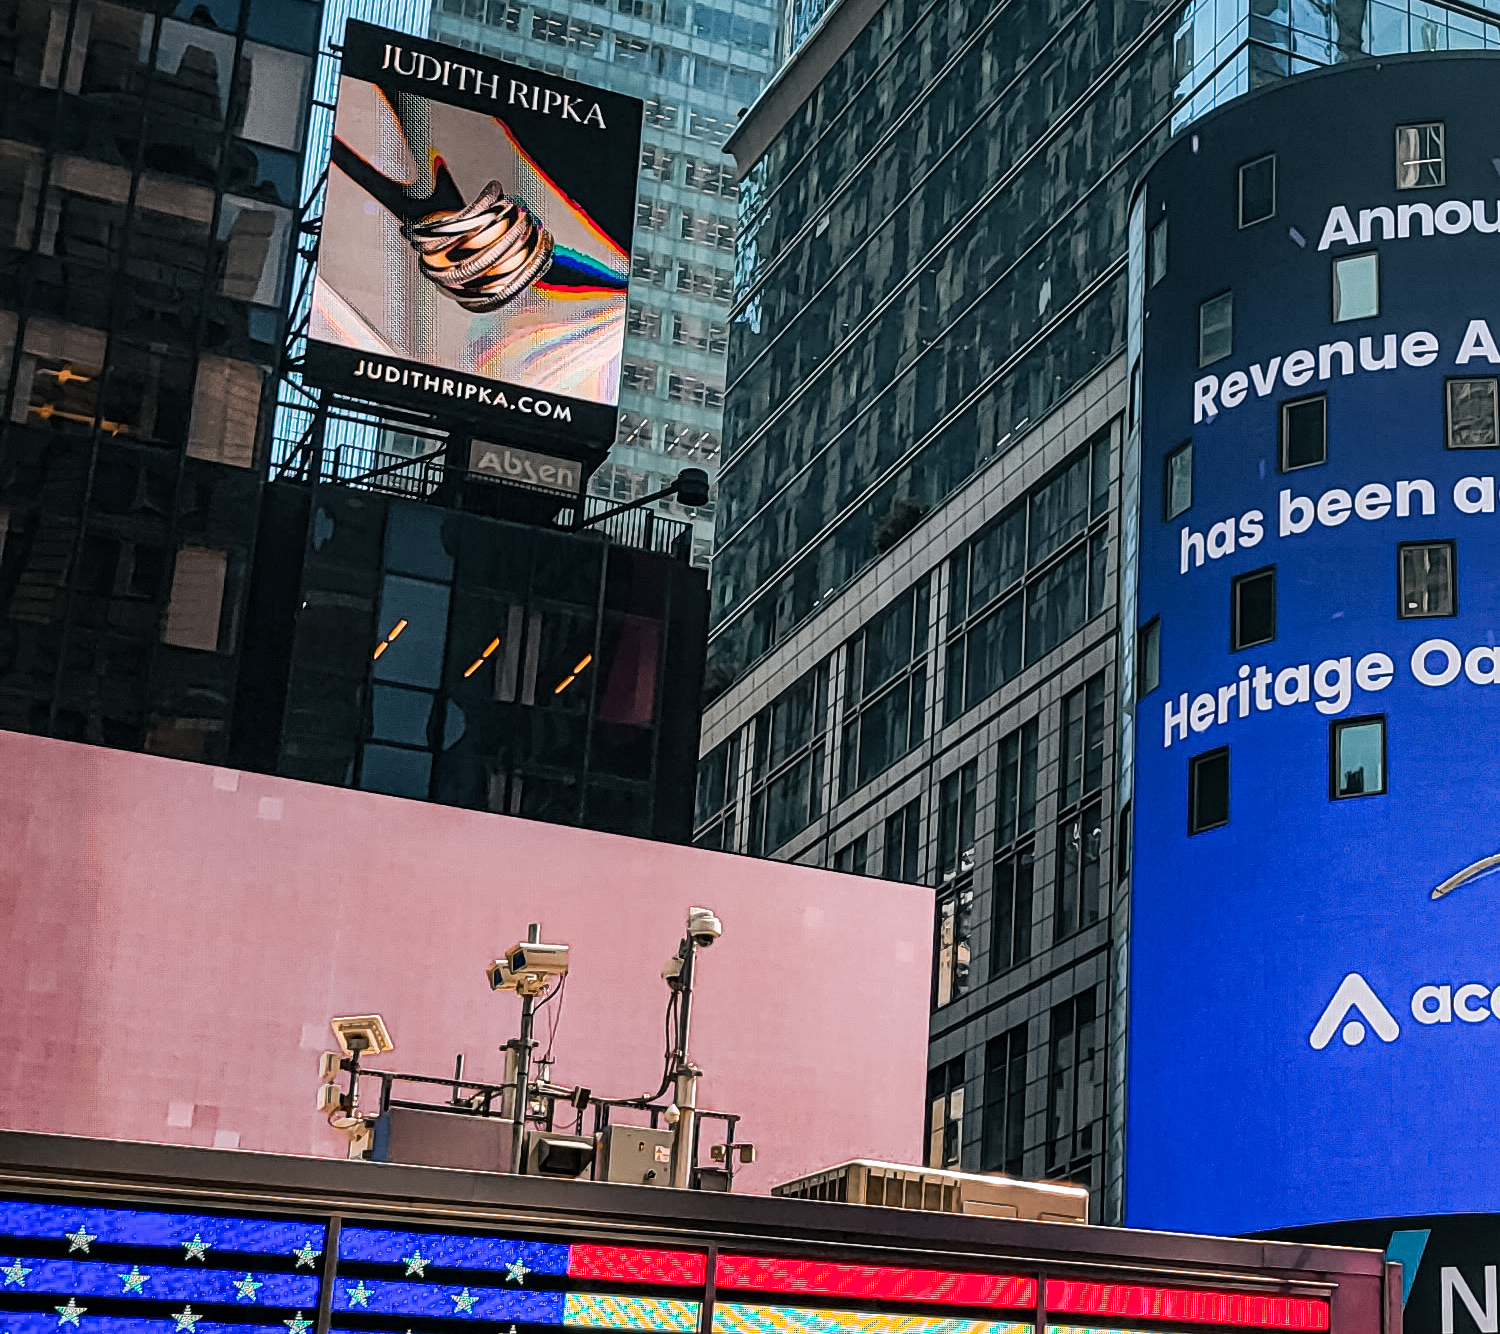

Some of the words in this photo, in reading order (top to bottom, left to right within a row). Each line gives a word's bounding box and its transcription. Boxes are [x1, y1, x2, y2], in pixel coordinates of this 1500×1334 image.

[379, 41, 500, 102] JUDITH
[505, 78, 607, 130] RIPKA
[354, 358, 574, 424] JUDITHRIPKA.COM
[1192, 321, 1440, 425] Revenue
[477, 450, 574, 488] Absen
[1180, 508, 1265, 575] has
[1278, 474, 1437, 539] been
[1163, 645, 1395, 748] Heritage
